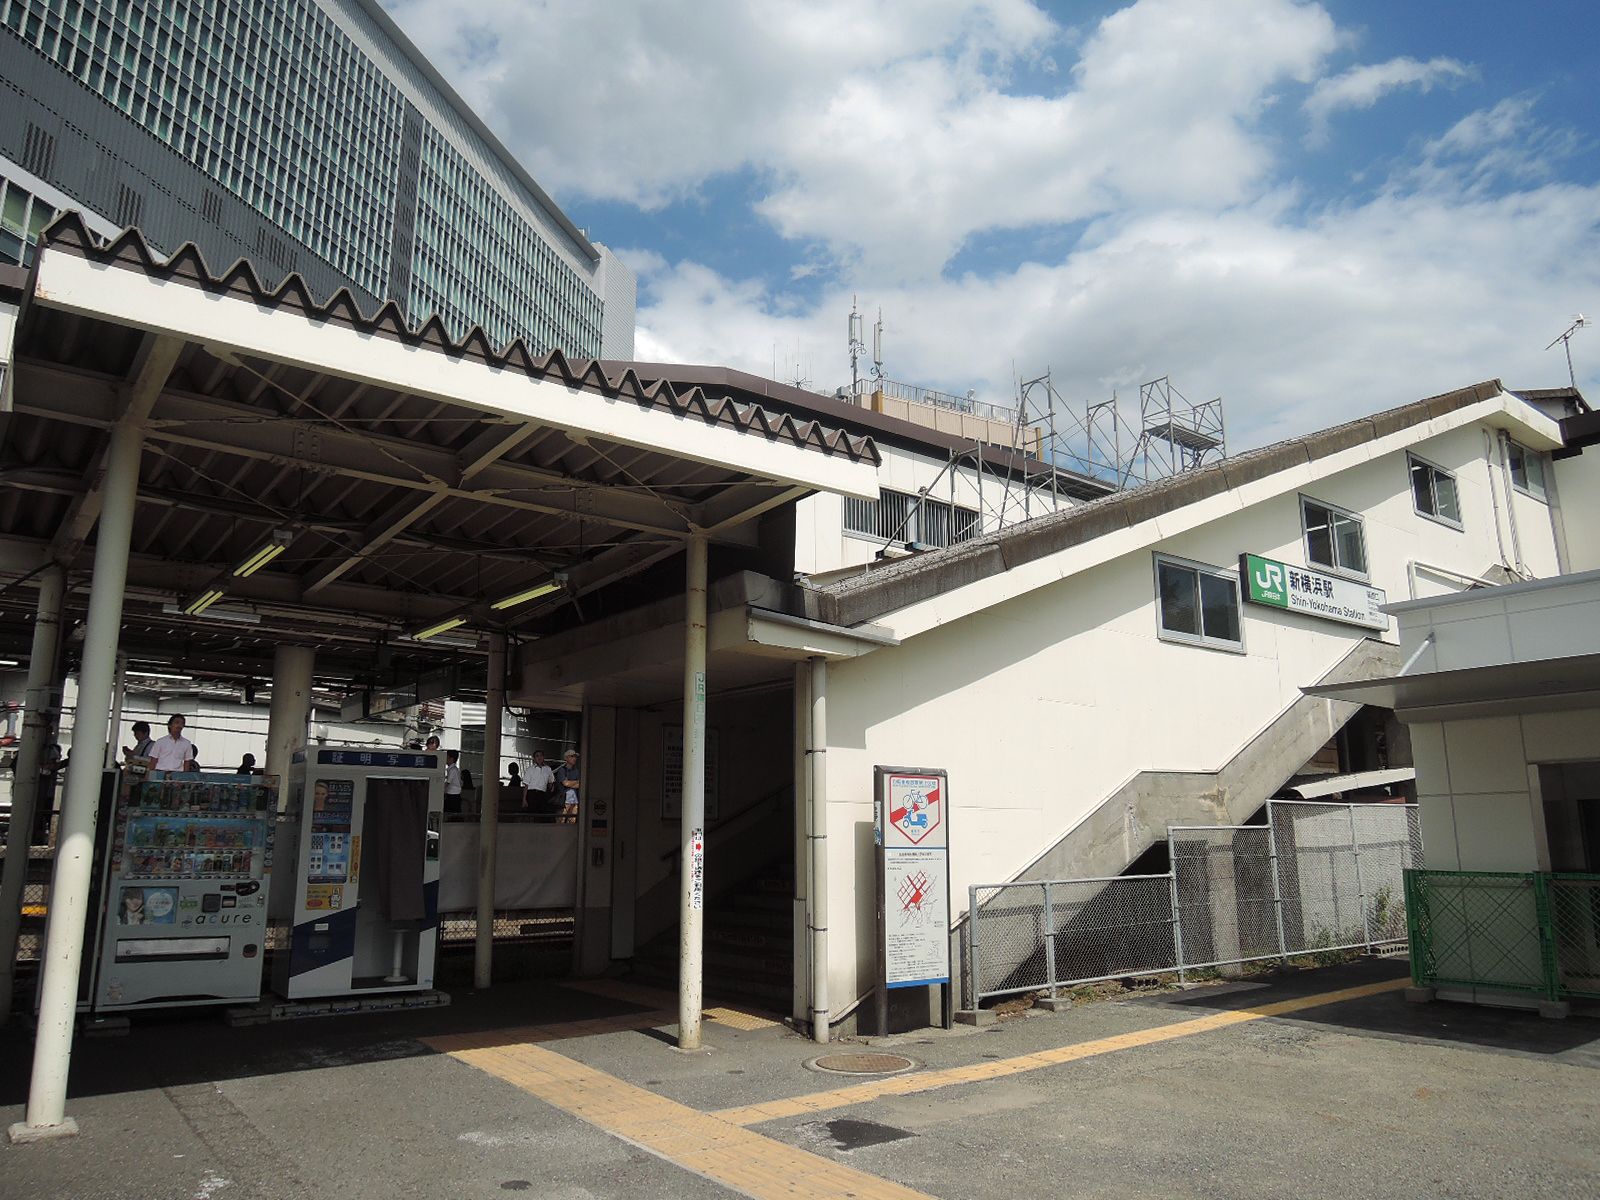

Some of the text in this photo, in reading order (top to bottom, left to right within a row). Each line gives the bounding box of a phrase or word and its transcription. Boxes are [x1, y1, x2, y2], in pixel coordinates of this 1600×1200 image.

[1256, 563, 1283, 593] JR
[1289, 570, 1334, 599] 新横浜駅
[1291, 594, 1343, 616] Shin-Yokohama
[1343, 606, 1366, 621] Station
[195, 913, 252, 925] acure
